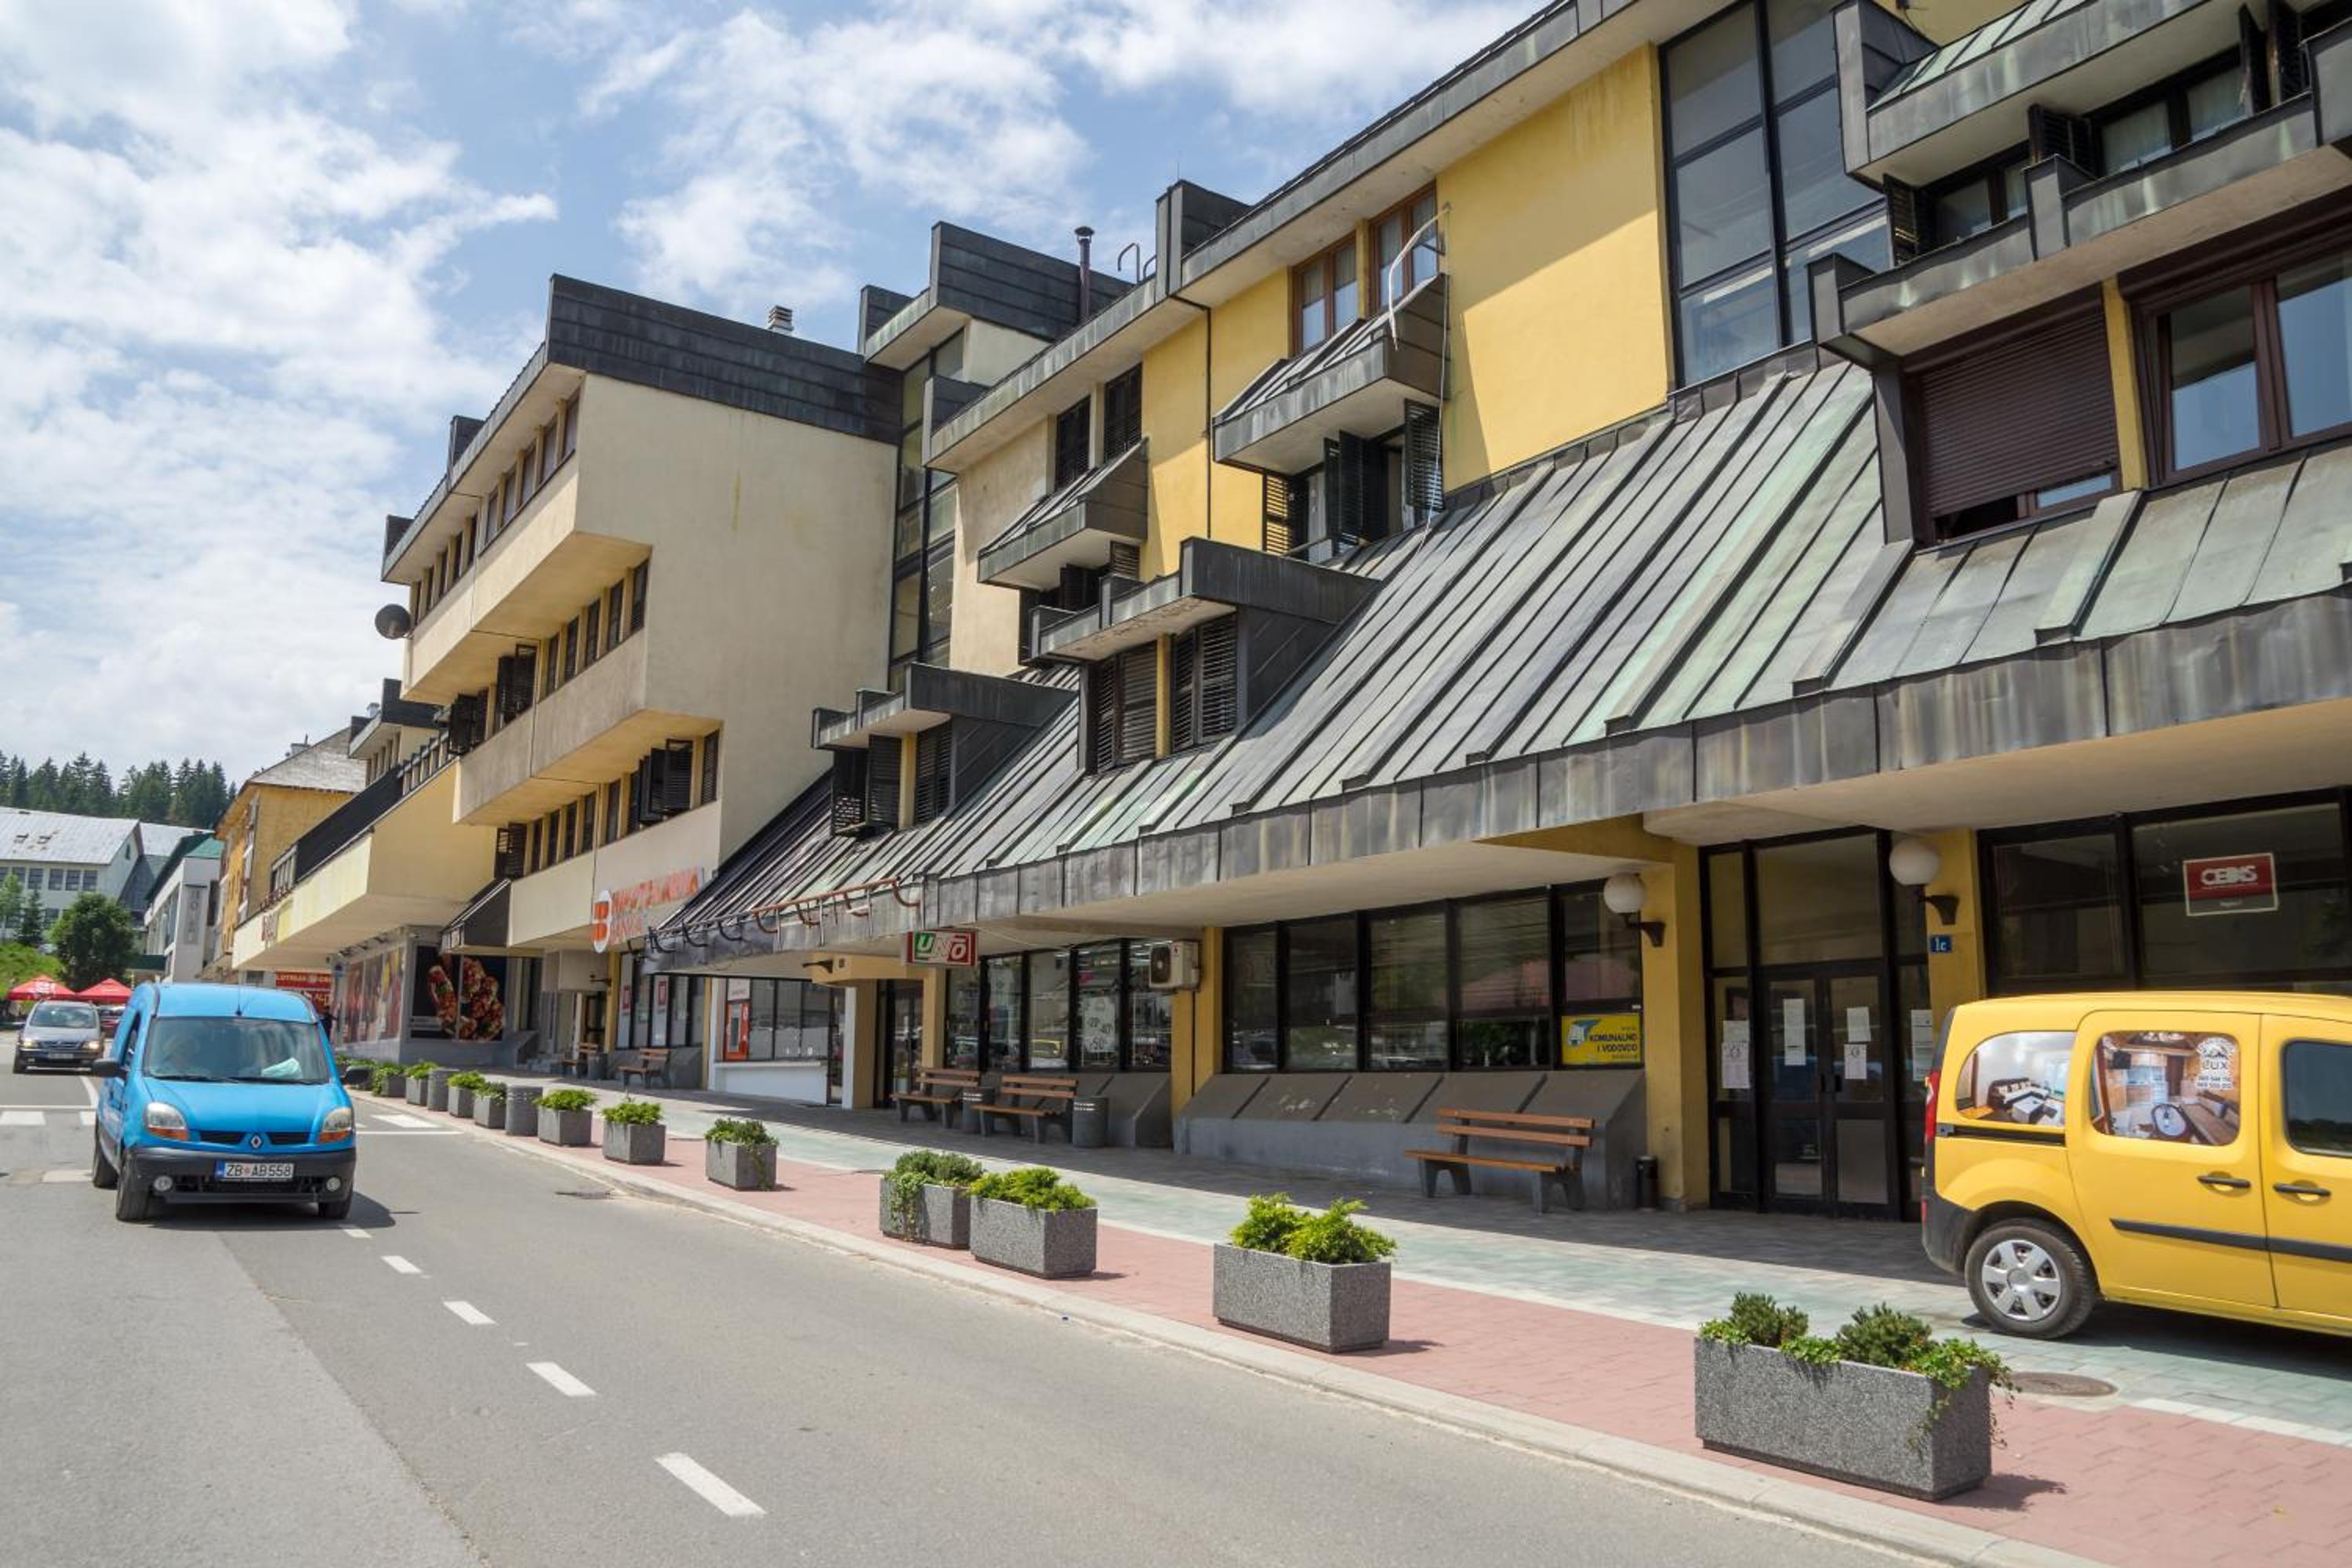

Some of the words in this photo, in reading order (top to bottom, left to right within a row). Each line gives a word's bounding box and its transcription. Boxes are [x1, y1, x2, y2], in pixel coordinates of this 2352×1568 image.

[1589, 1033, 1638, 1042] KOMUNALNO
[1602, 1044, 1638, 1052] VODOVOD
[227, 1164, 243, 1177] ZB
